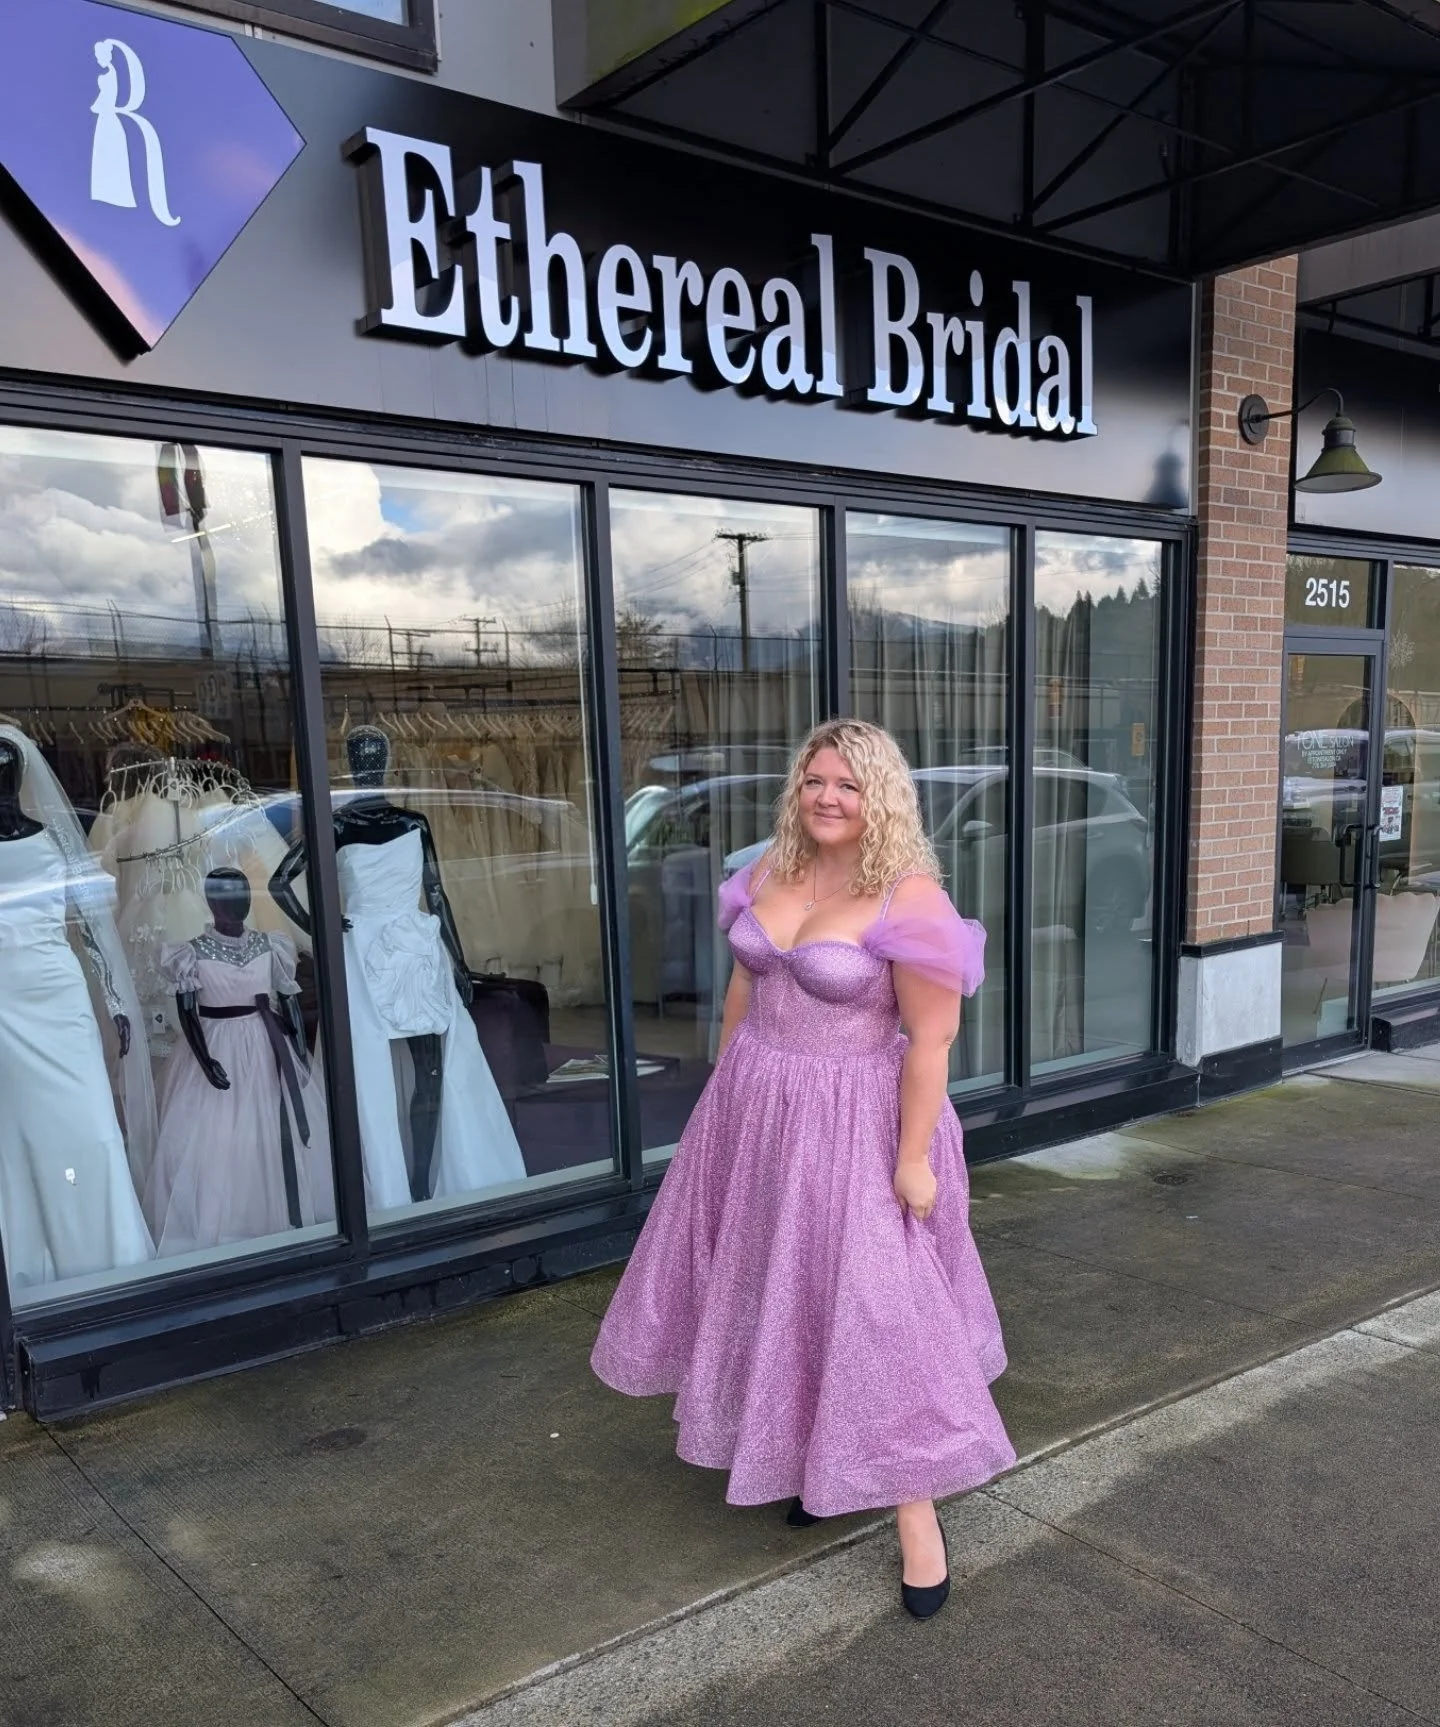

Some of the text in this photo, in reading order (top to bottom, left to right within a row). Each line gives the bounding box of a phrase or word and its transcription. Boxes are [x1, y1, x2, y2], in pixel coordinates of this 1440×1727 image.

[365, 127, 1098, 436] Ethereal Bridal
[1305, 577, 1350, 608] 2515
